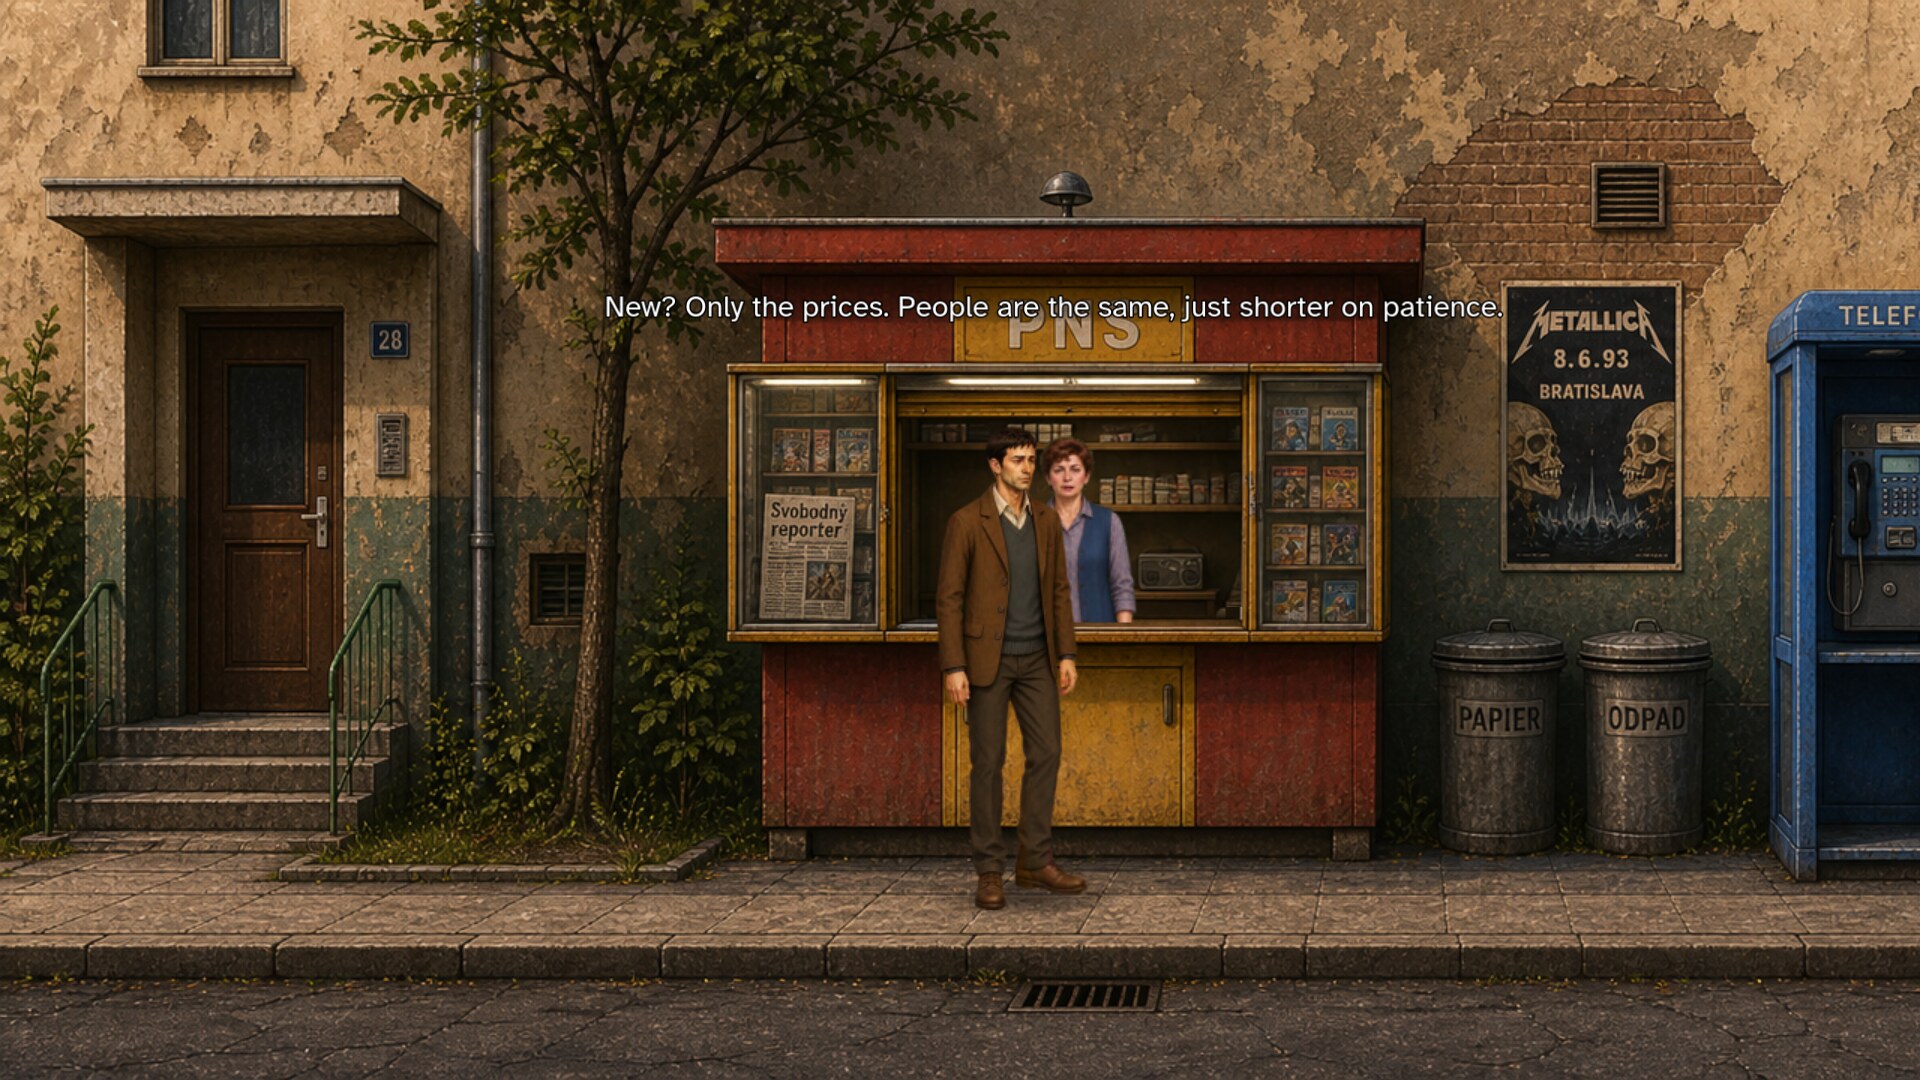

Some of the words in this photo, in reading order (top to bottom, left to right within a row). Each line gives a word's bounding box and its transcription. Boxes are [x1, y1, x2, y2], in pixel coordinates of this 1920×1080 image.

[1008, 299, 1141, 350] PNS
[1839, 305, 1920, 326] TELEF
[378, 329, 402, 350] 28
[1511, 299, 1673, 364] METALLICA
[1553, 348, 1630, 369] 8.6.93
[1539, 383, 1645, 400] BRATISLAVA
[771, 521, 842, 543] reporter
[1459, 705, 1541, 732] PAPIER
[1608, 705, 1686, 731] ODPAD
